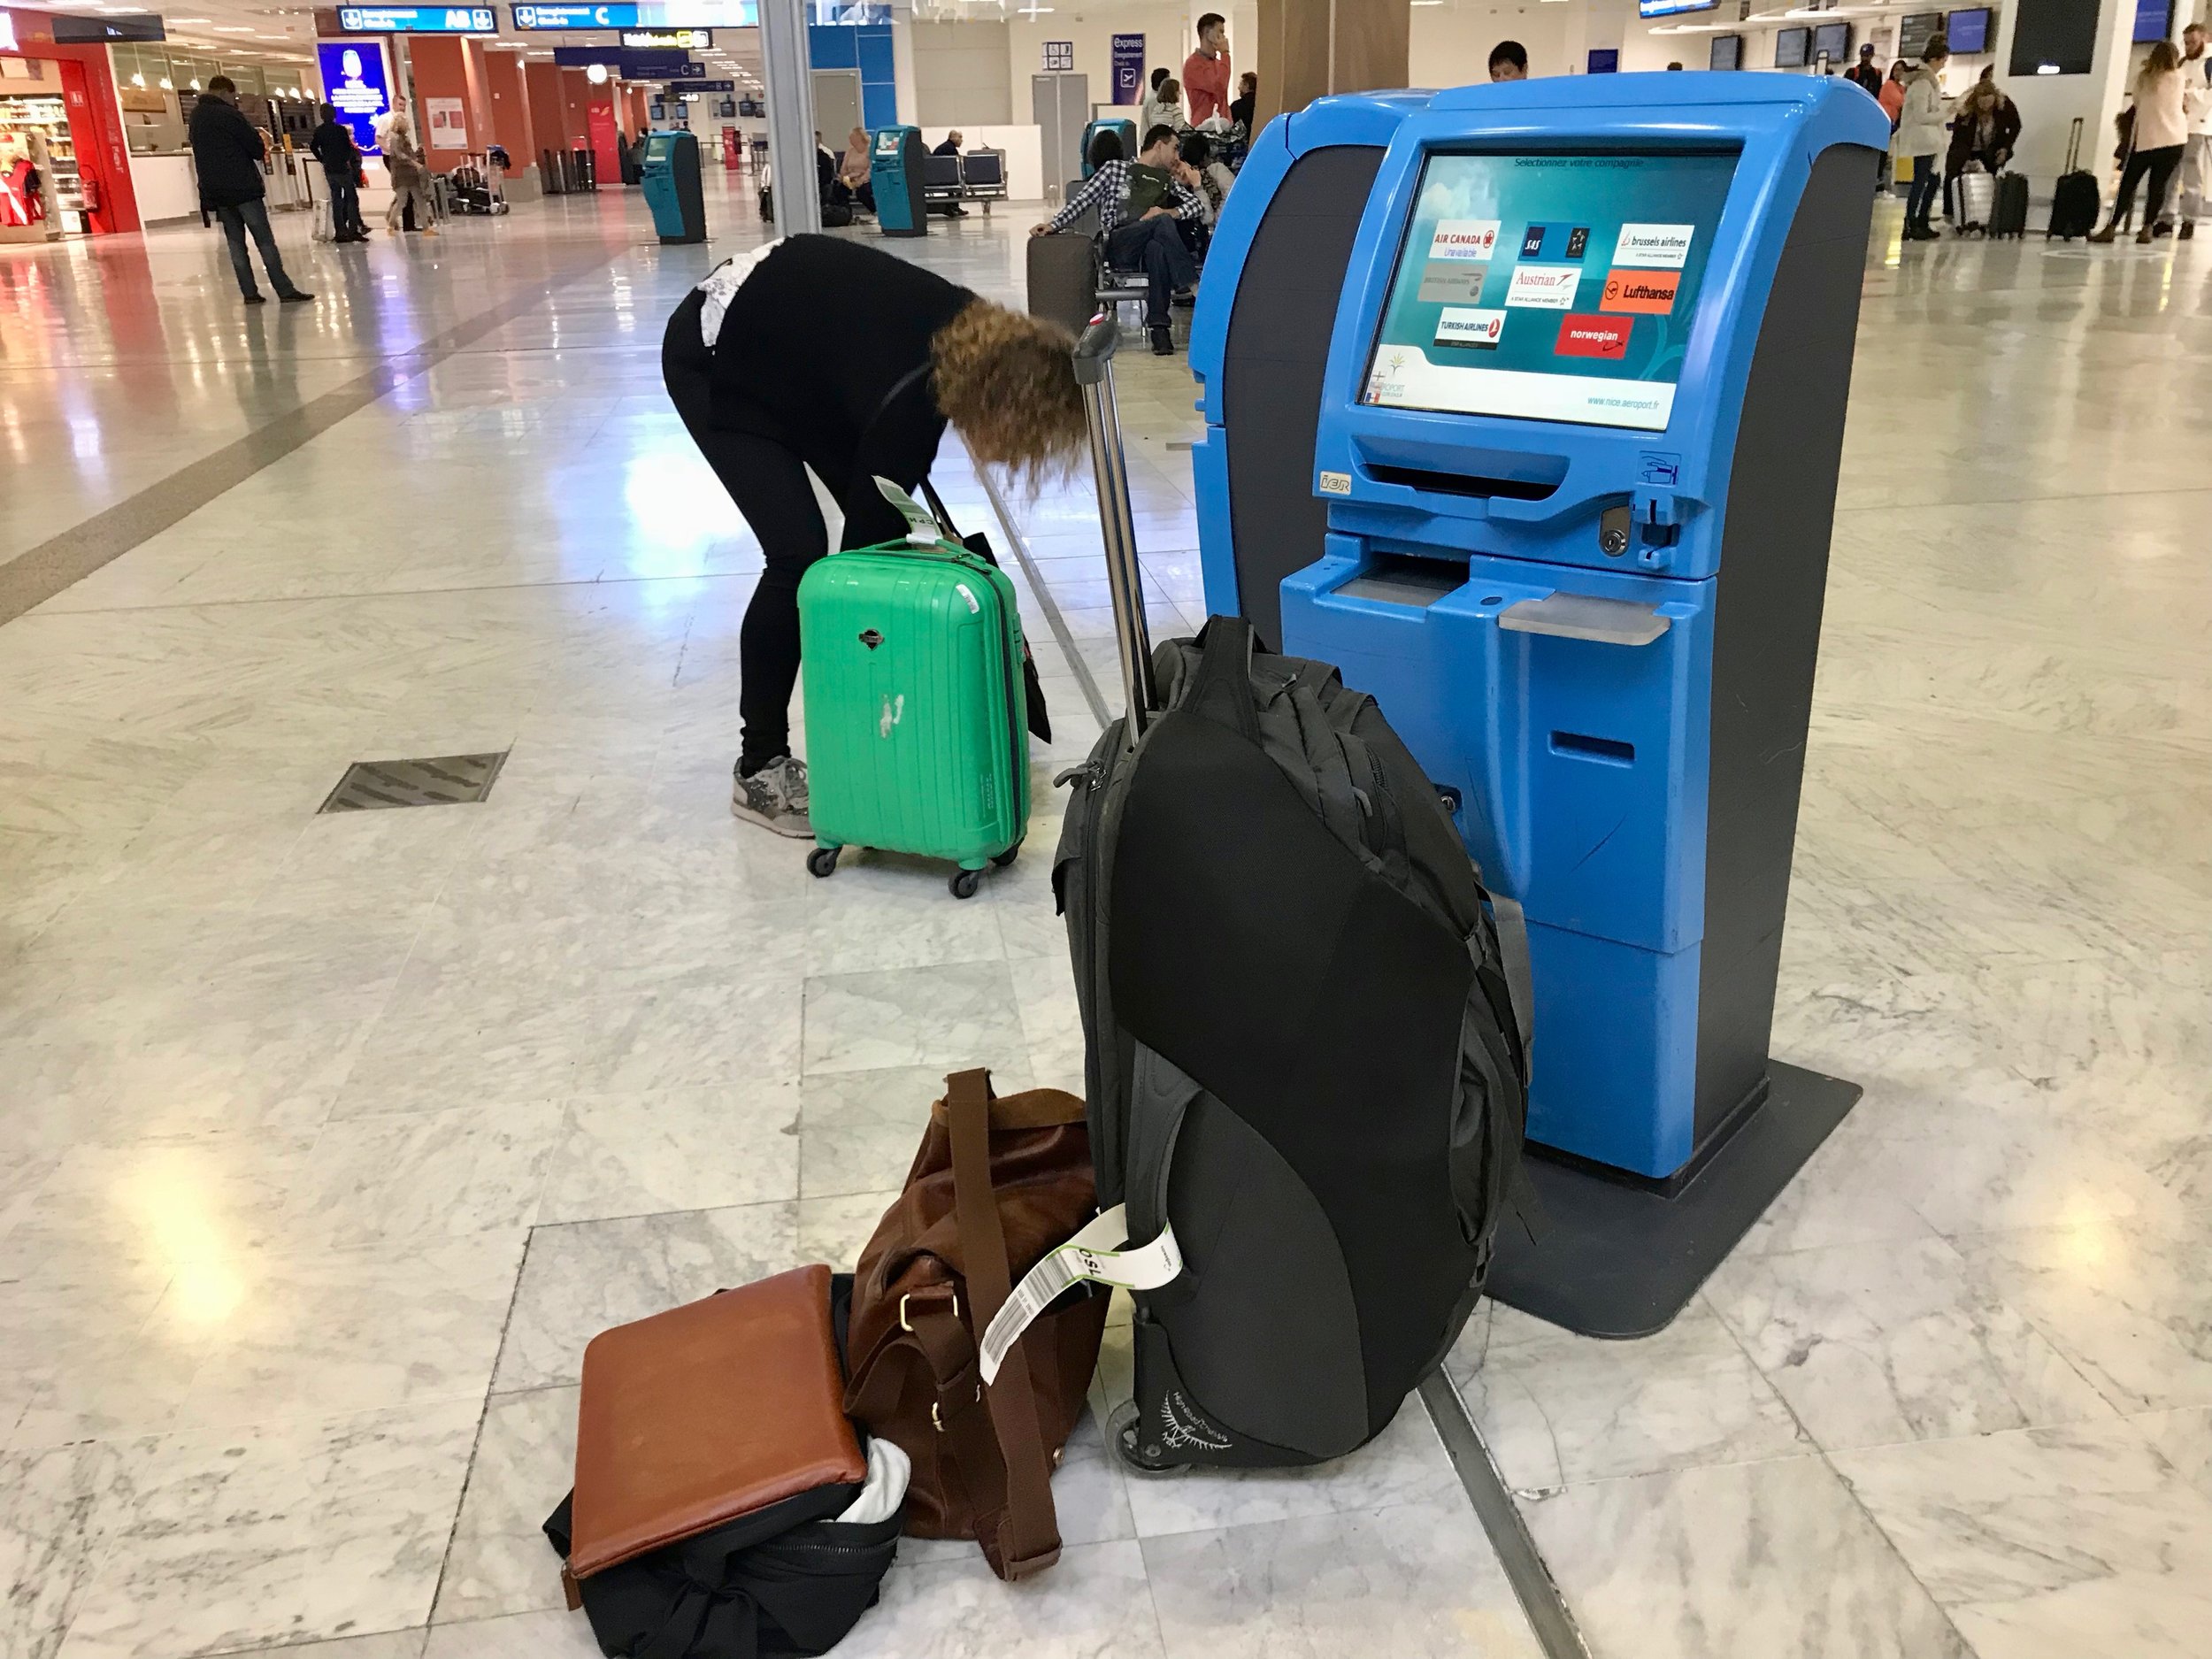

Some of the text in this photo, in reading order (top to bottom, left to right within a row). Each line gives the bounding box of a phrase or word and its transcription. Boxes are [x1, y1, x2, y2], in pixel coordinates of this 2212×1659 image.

[595, 7, 610, 25] C
[1570, 158, 1593, 167] votre
[1594, 159, 1645, 169] compagnie
[1434, 234, 1481, 245] AIR CANADA
[1525, 239, 1541, 250] SAS
[1632, 235, 1687, 248] brussels airlines
[1444, 247, 1478, 257] Unavailable
[1516, 271, 1555, 287] Austrian
[1623, 284, 1675, 300] Lufthansa
[1441, 320, 1489, 332] TURKISH AIRLINES
[1570, 329, 1618, 342] norwegian
[1587, 396, 1660, 411] www.nice.aeroport.fr
[1079, 1248, 1102, 1276] OSL
